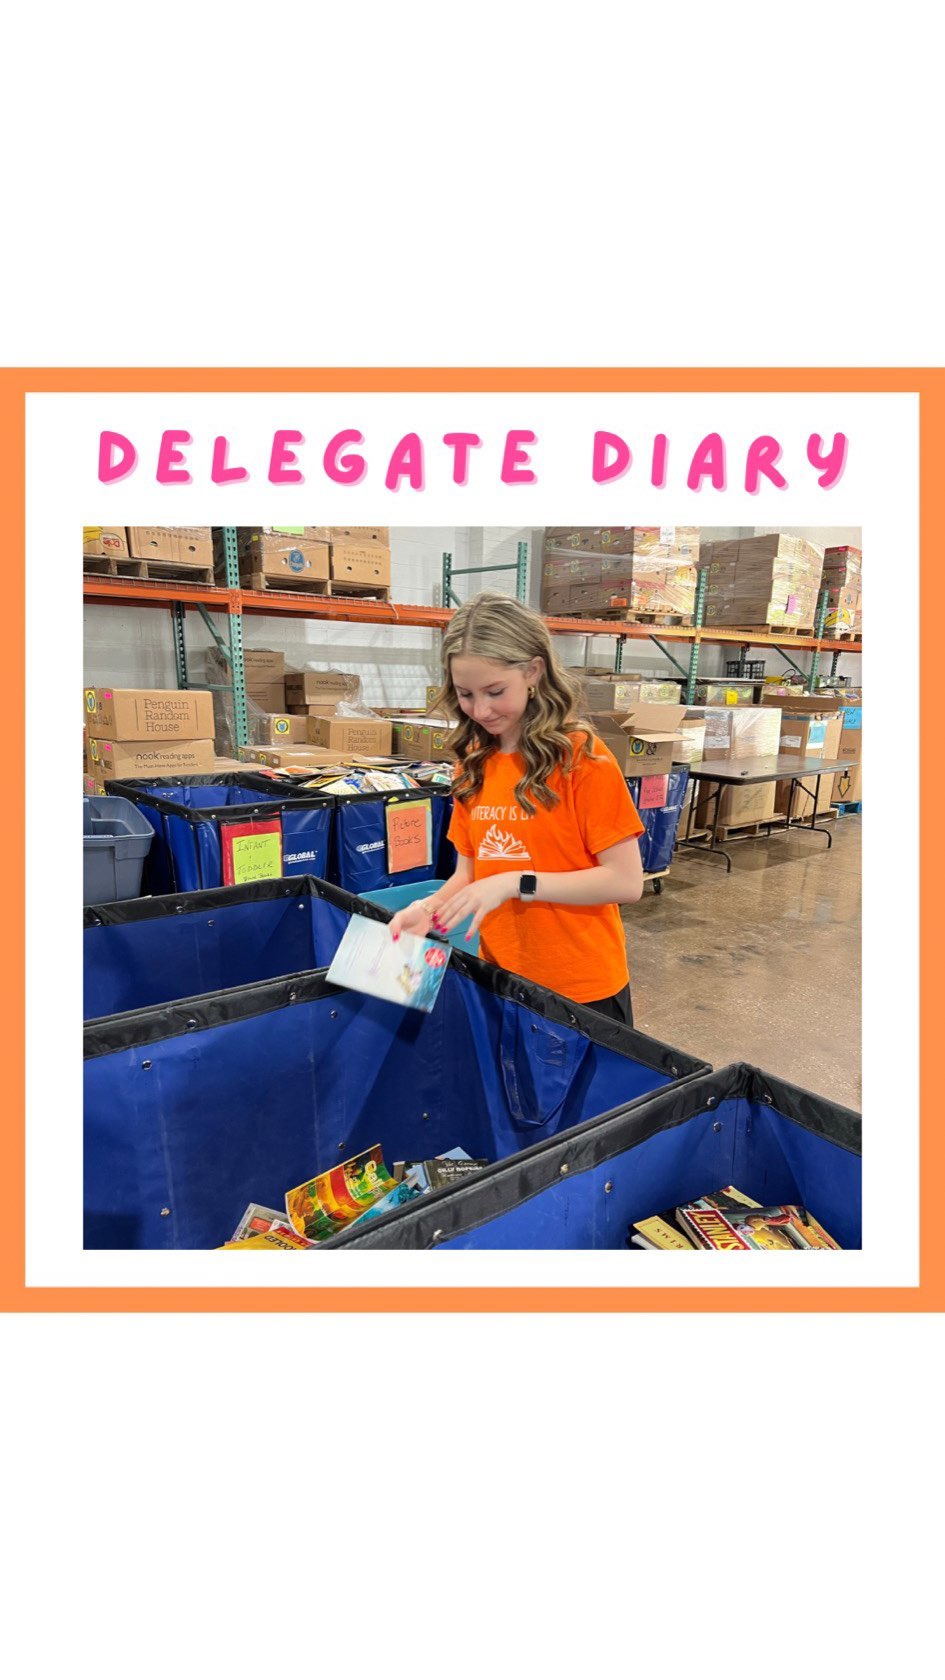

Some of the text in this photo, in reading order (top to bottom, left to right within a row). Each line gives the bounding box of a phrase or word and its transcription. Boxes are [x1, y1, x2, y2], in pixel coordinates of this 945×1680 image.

[143, 699, 190, 711] Penguin
[145, 710, 190, 720] Random
[146, 722, 180, 732] House
[136, 752, 160, 760] nook
[510, 805, 518, 820] IS
[236, 839, 270, 852] INFANT
[288, 850, 316, 861] GLOBAL
[690, 1211, 745, 1250] STANLEY
